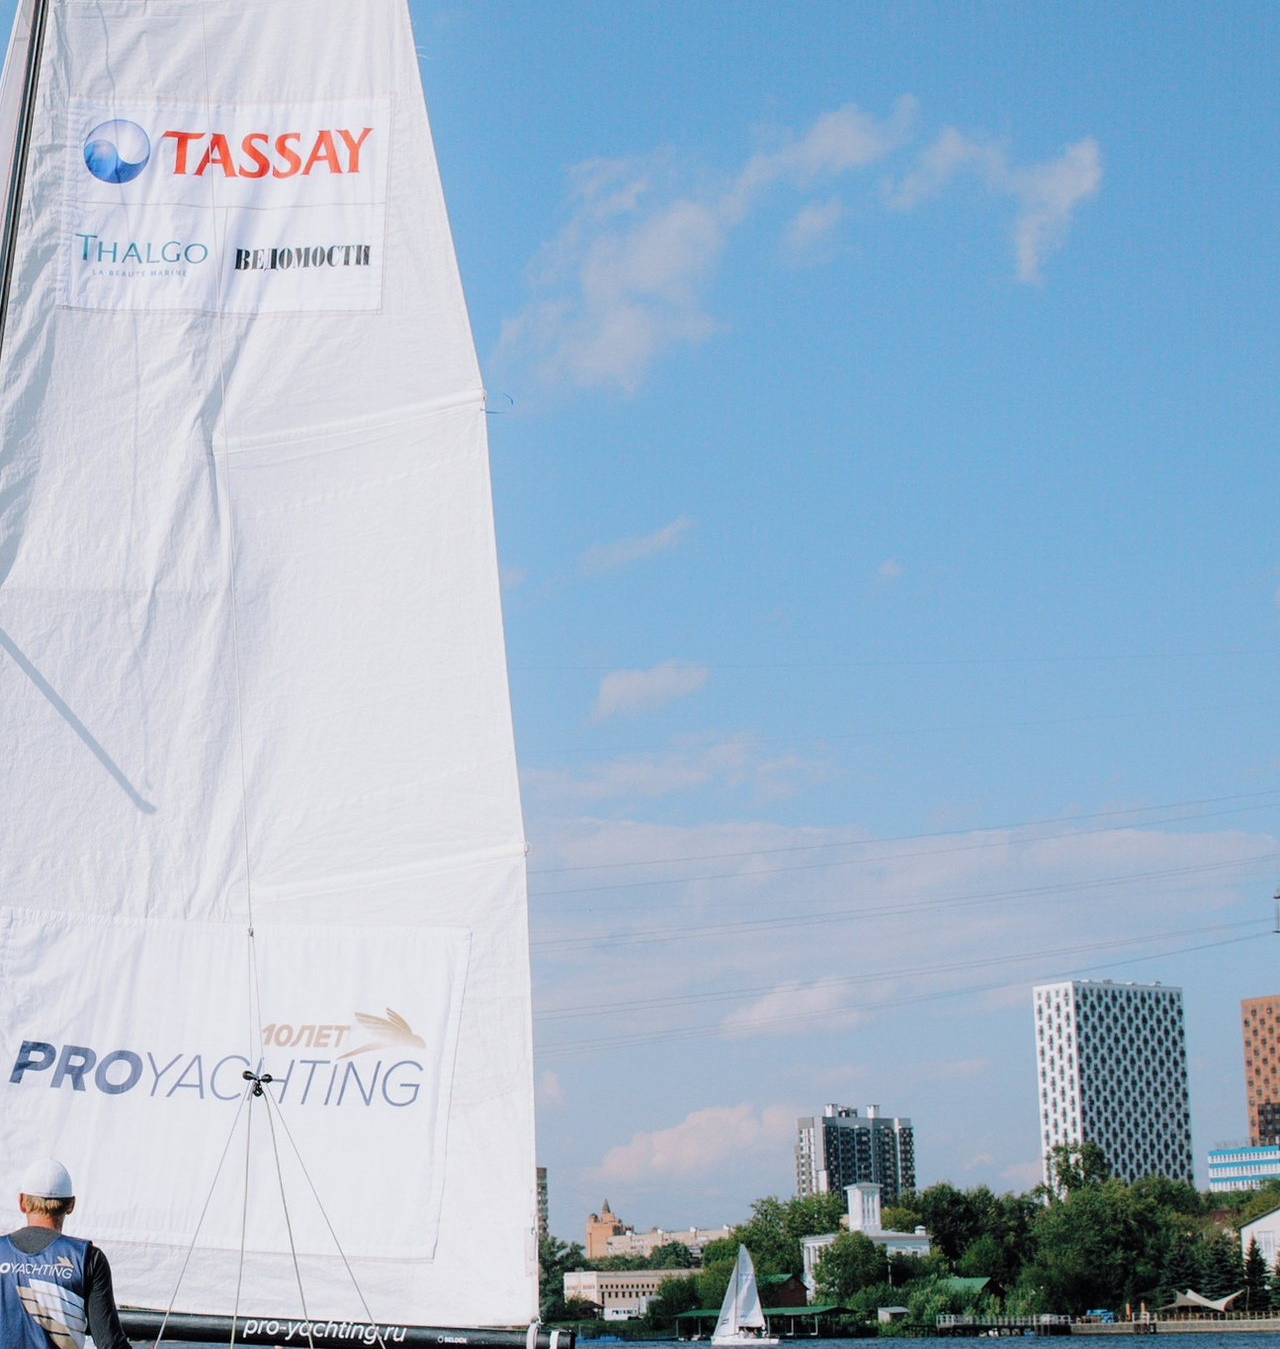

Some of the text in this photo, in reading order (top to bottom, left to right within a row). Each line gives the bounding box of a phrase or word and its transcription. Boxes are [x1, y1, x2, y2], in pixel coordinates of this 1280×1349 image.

[161, 127, 374, 179] TASSAY
[74, 233, 209, 264] THALGO
[234, 244, 372, 271] ВЕДОМОСТИ
[9, 1040, 424, 1108] PROYACHTING
[243, 1318, 407, 1345] pro-yachting.ru
